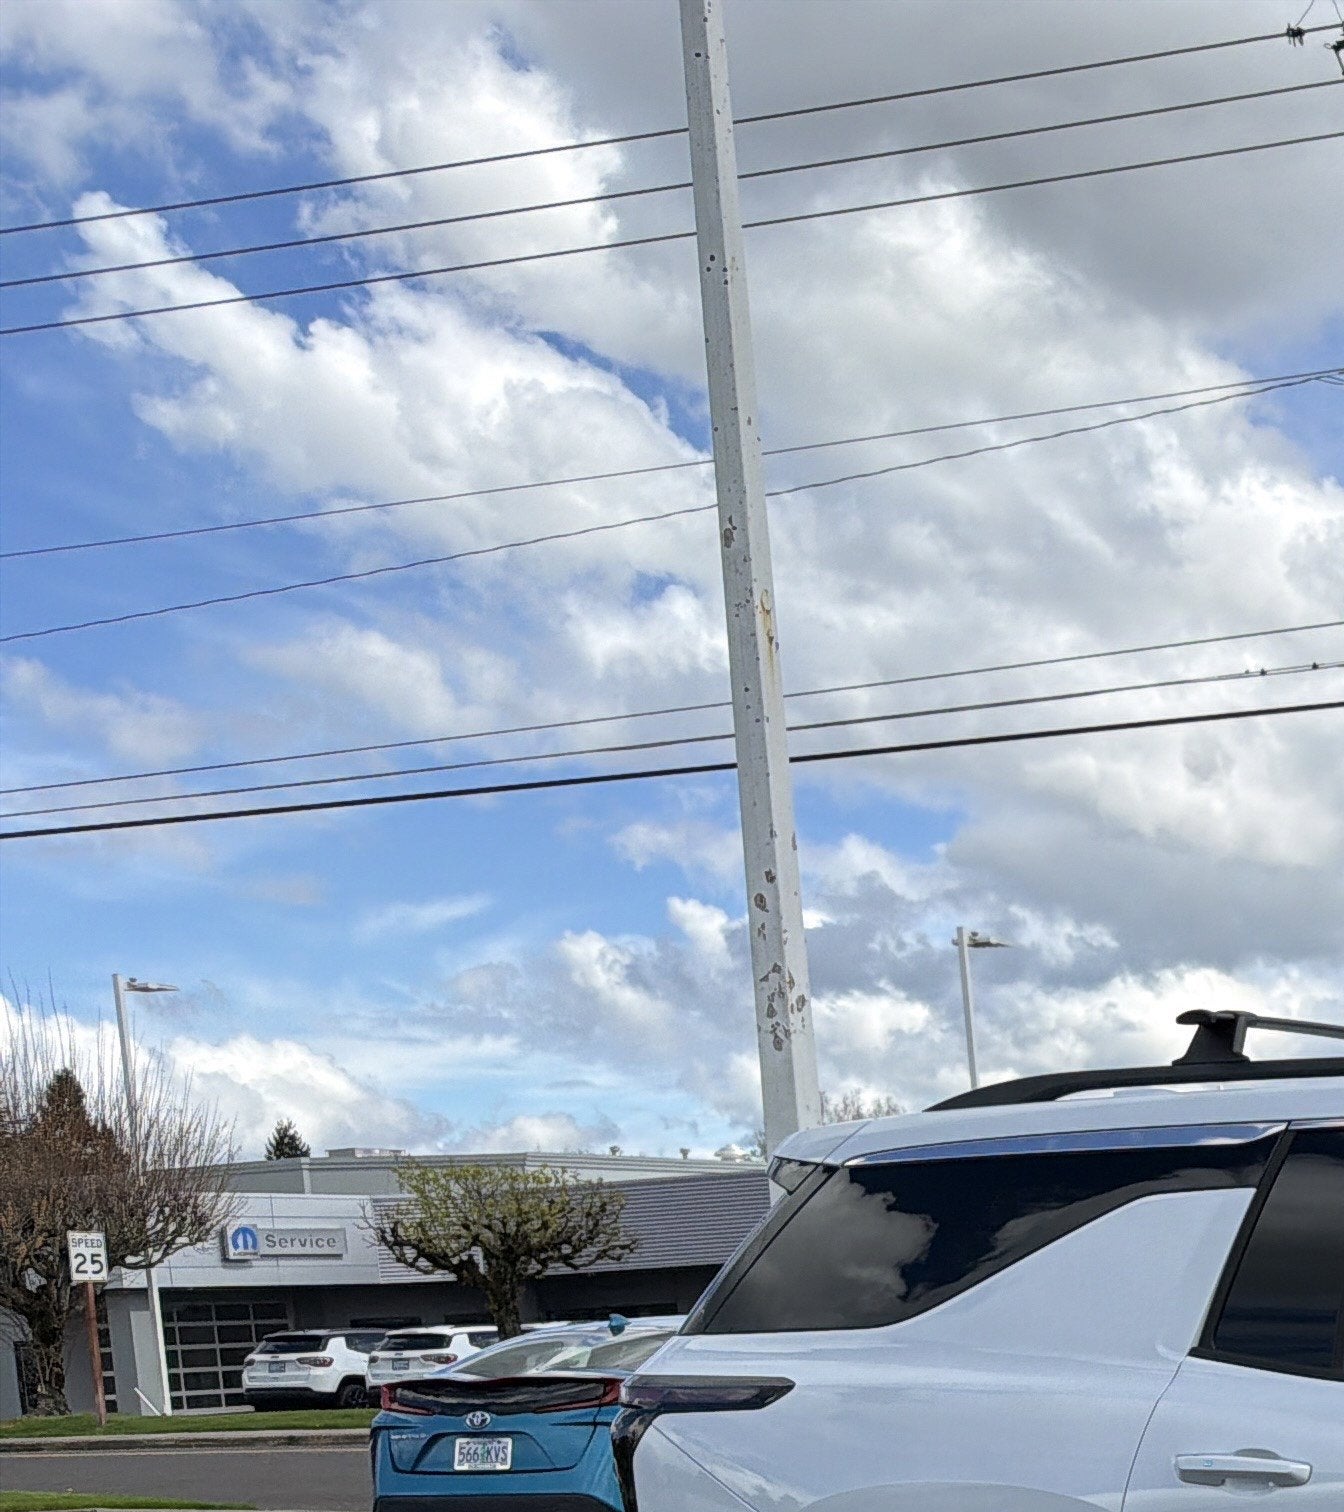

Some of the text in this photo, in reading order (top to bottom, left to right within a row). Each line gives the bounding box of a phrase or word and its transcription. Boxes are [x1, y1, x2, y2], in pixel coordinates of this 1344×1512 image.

[71, 1238, 103, 1248] SPEED
[265, 1234, 337, 1248] Service
[74, 1253, 103, 1274] 25
[459, 1446, 480, 1463] 566
